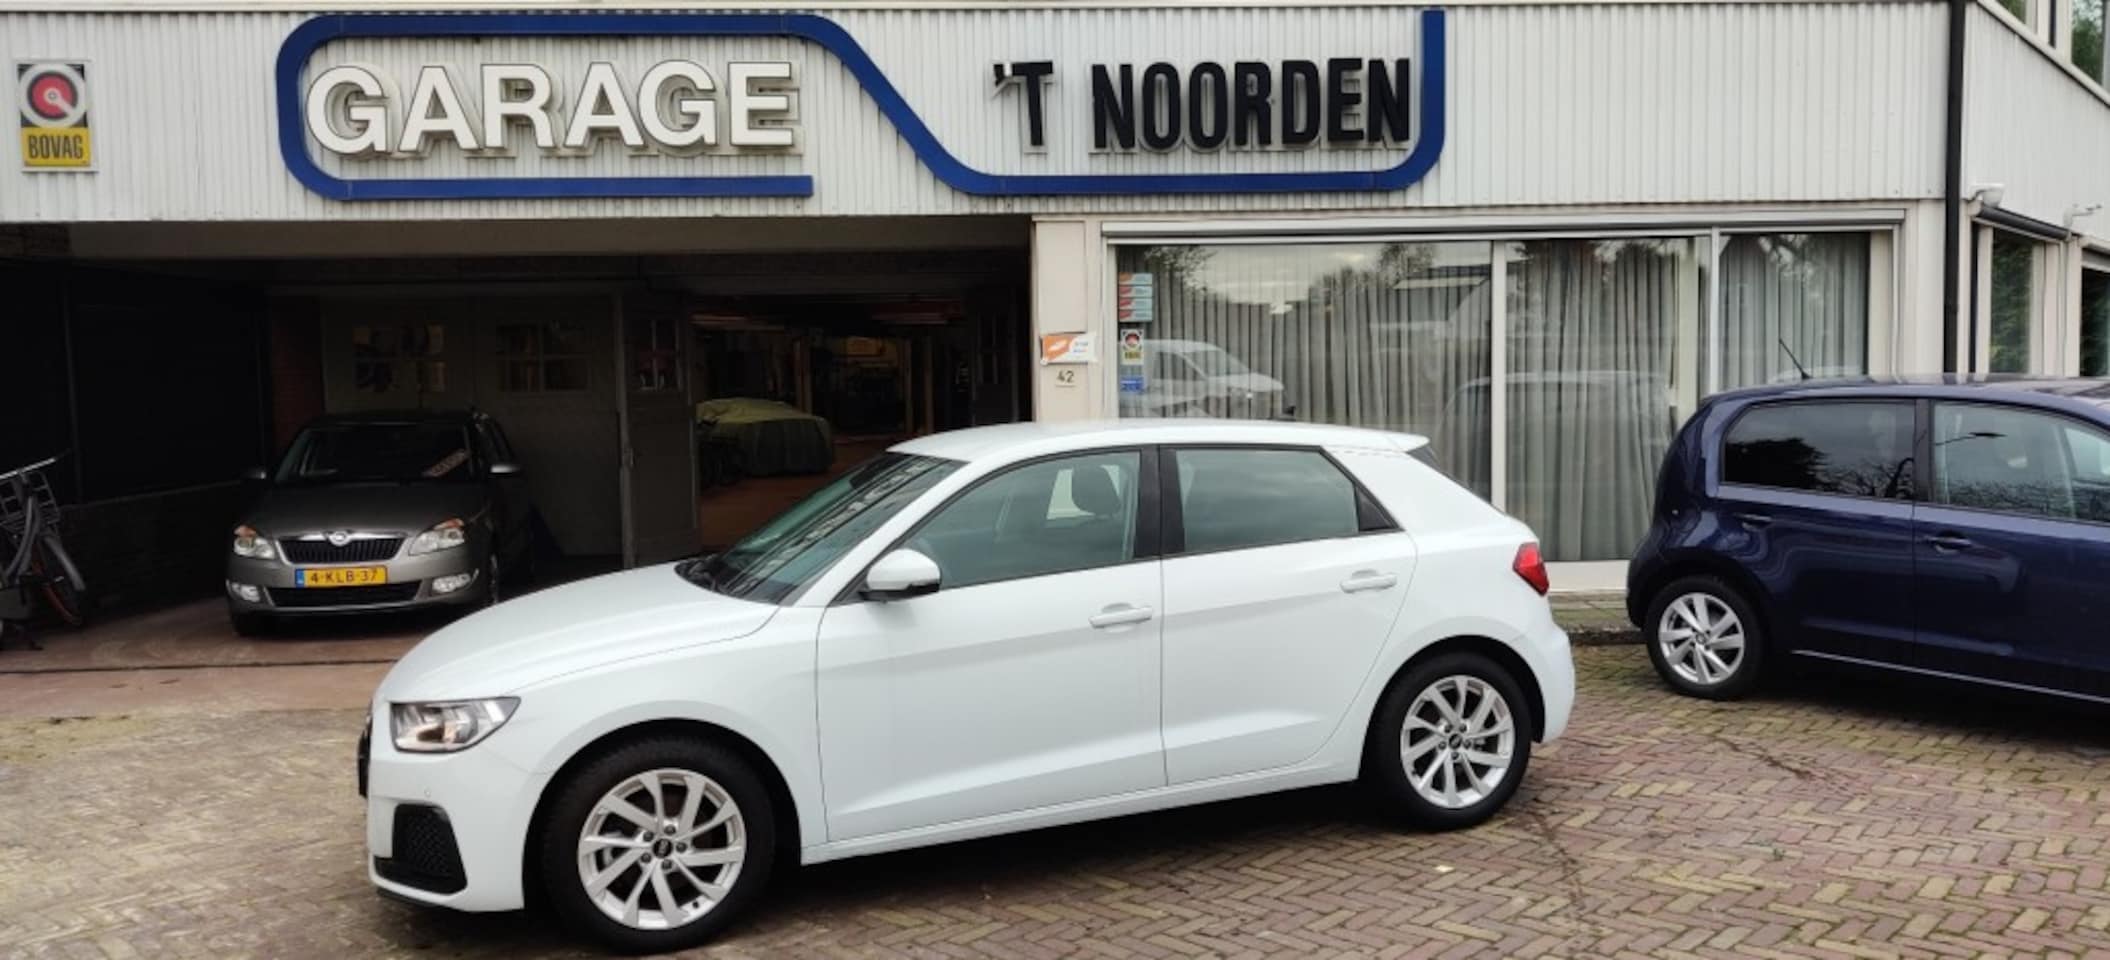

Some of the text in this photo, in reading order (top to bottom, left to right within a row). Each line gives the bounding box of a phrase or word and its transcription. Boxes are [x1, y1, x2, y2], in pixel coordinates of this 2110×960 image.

[306, 60, 796, 154] GARAGE
[1091, 58, 1411, 150] NOORDEN
[28, 134, 83, 159] BOVAG
[1056, 370, 1075, 383] 42
[310, 568, 378, 583] 4-KLB-37
